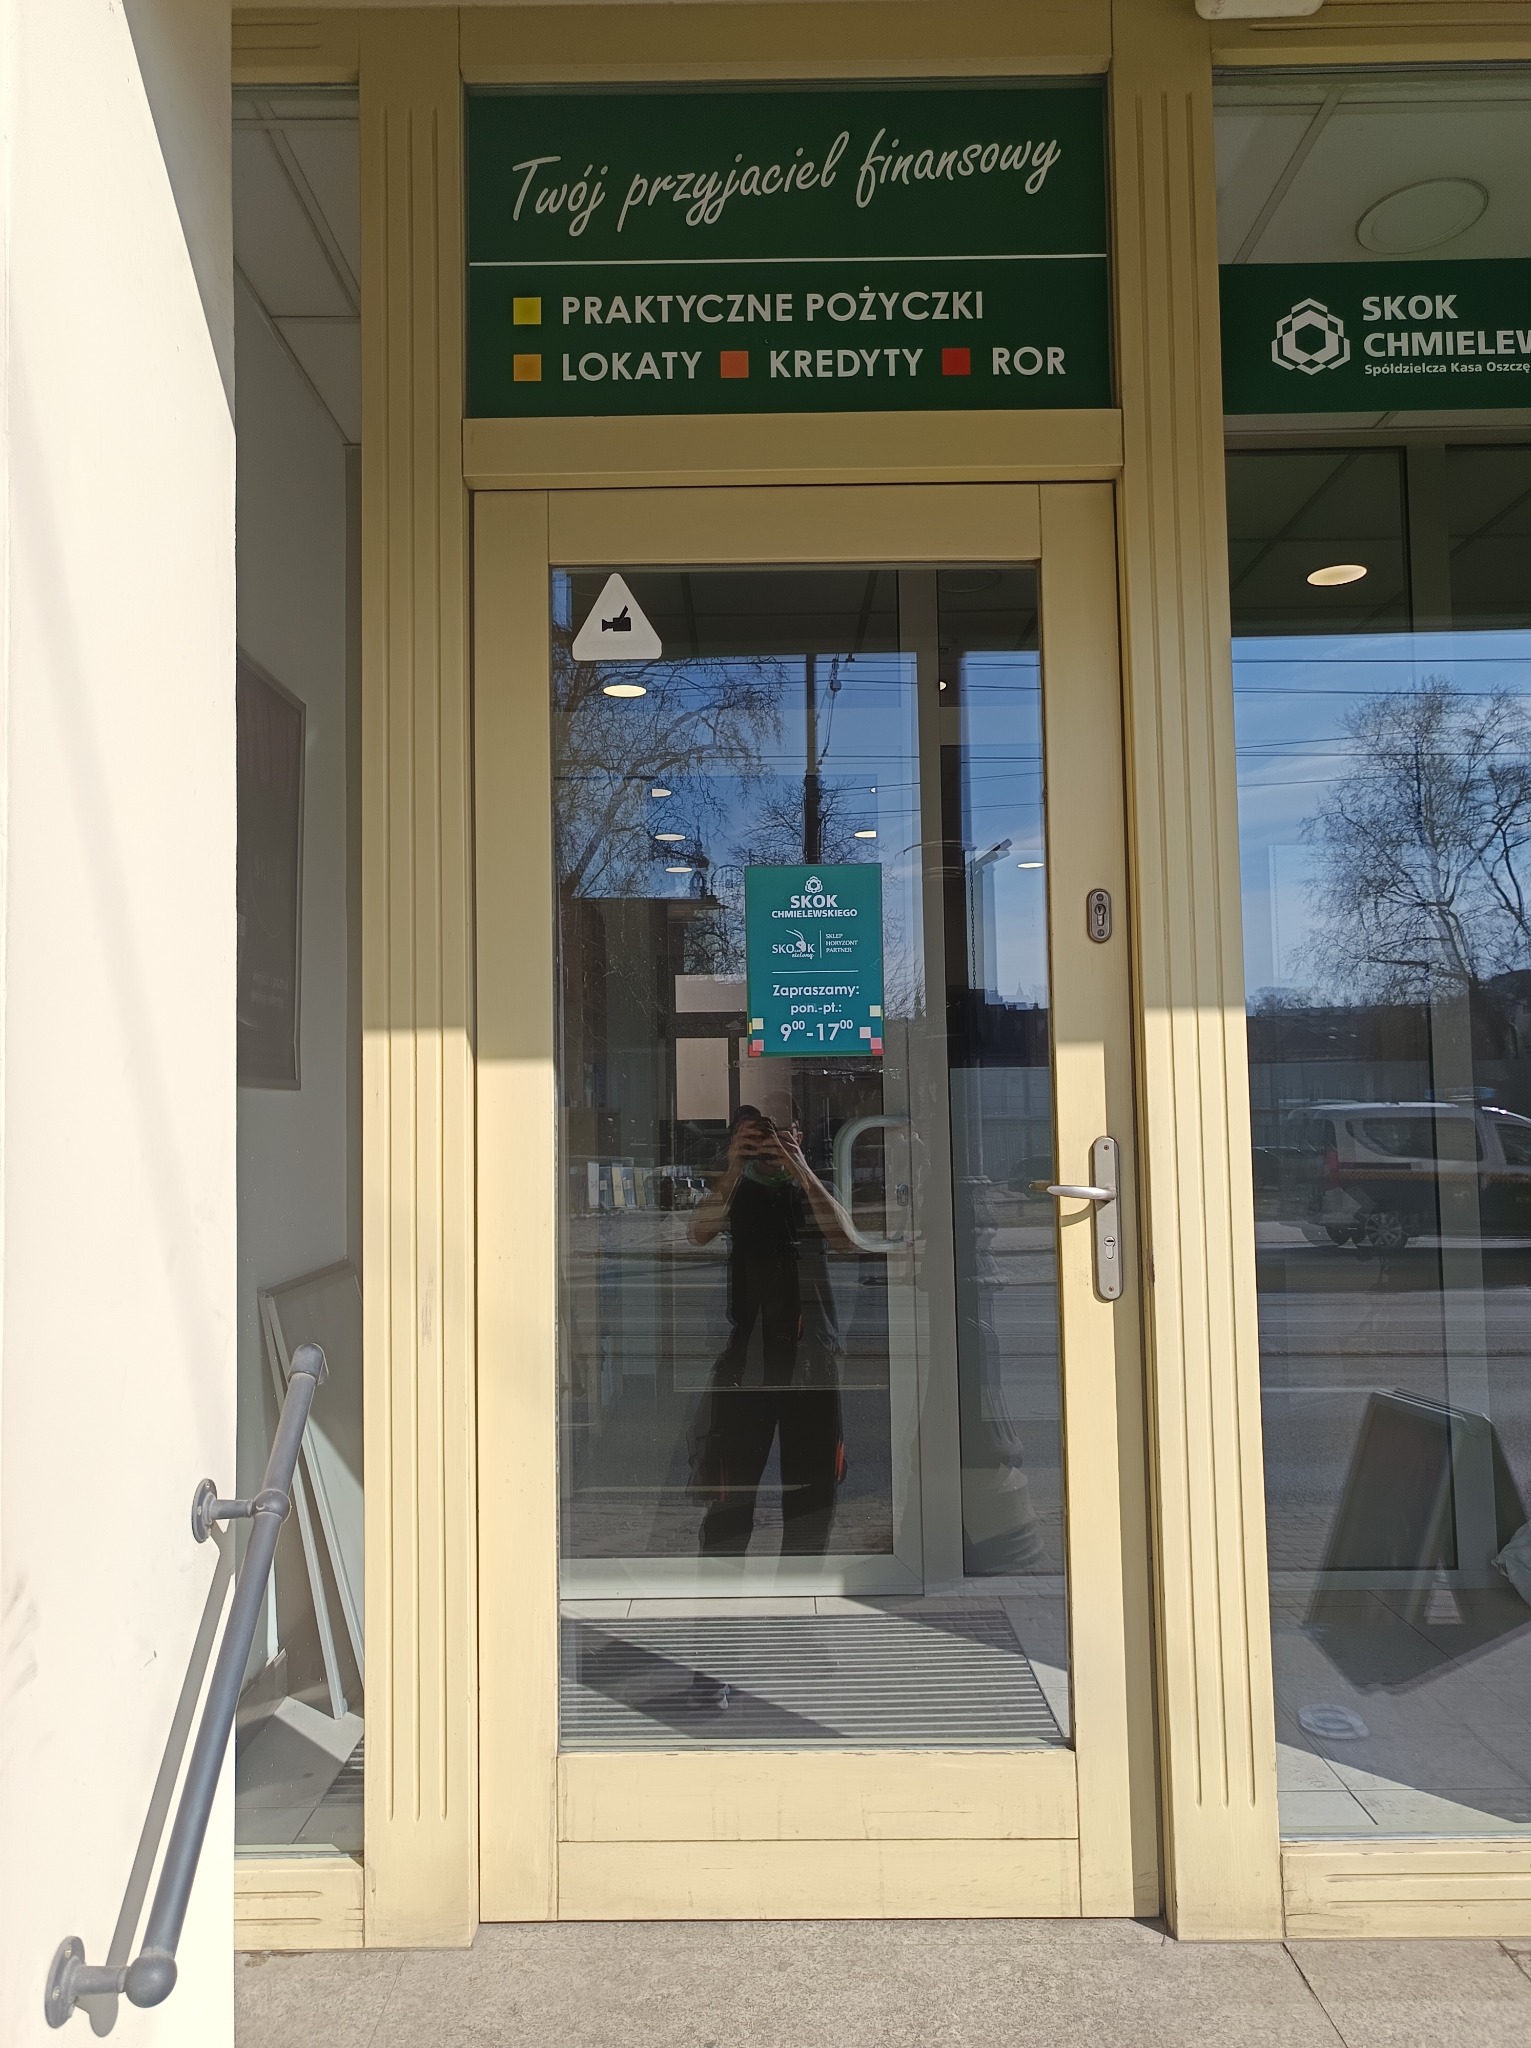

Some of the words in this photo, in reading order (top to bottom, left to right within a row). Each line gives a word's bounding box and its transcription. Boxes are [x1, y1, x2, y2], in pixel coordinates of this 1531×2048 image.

[511, 154, 609, 237] Twój
[616, 130, 850, 232] przyjaciel
[855, 127, 1062, 209] finansowy
[562, 293, 793, 325] PRAKTYCZNE
[806, 286, 984, 322] POŻYCZKI
[1362, 294, 1459, 322] SKOK
[562, 351, 703, 382] LOKATY
[770, 348, 924, 379] KREDYTY
[992, 346, 1067, 376] ROR
[1364, 362, 1447, 377] Spółdzielcza
[1450, 362, 1483, 373] Kasa
[790, 894, 839, 909] SKOK
[771, 909, 858, 919] CHMIELEWSKIEGO
[772, 984, 860, 999] Zapraszamy:
